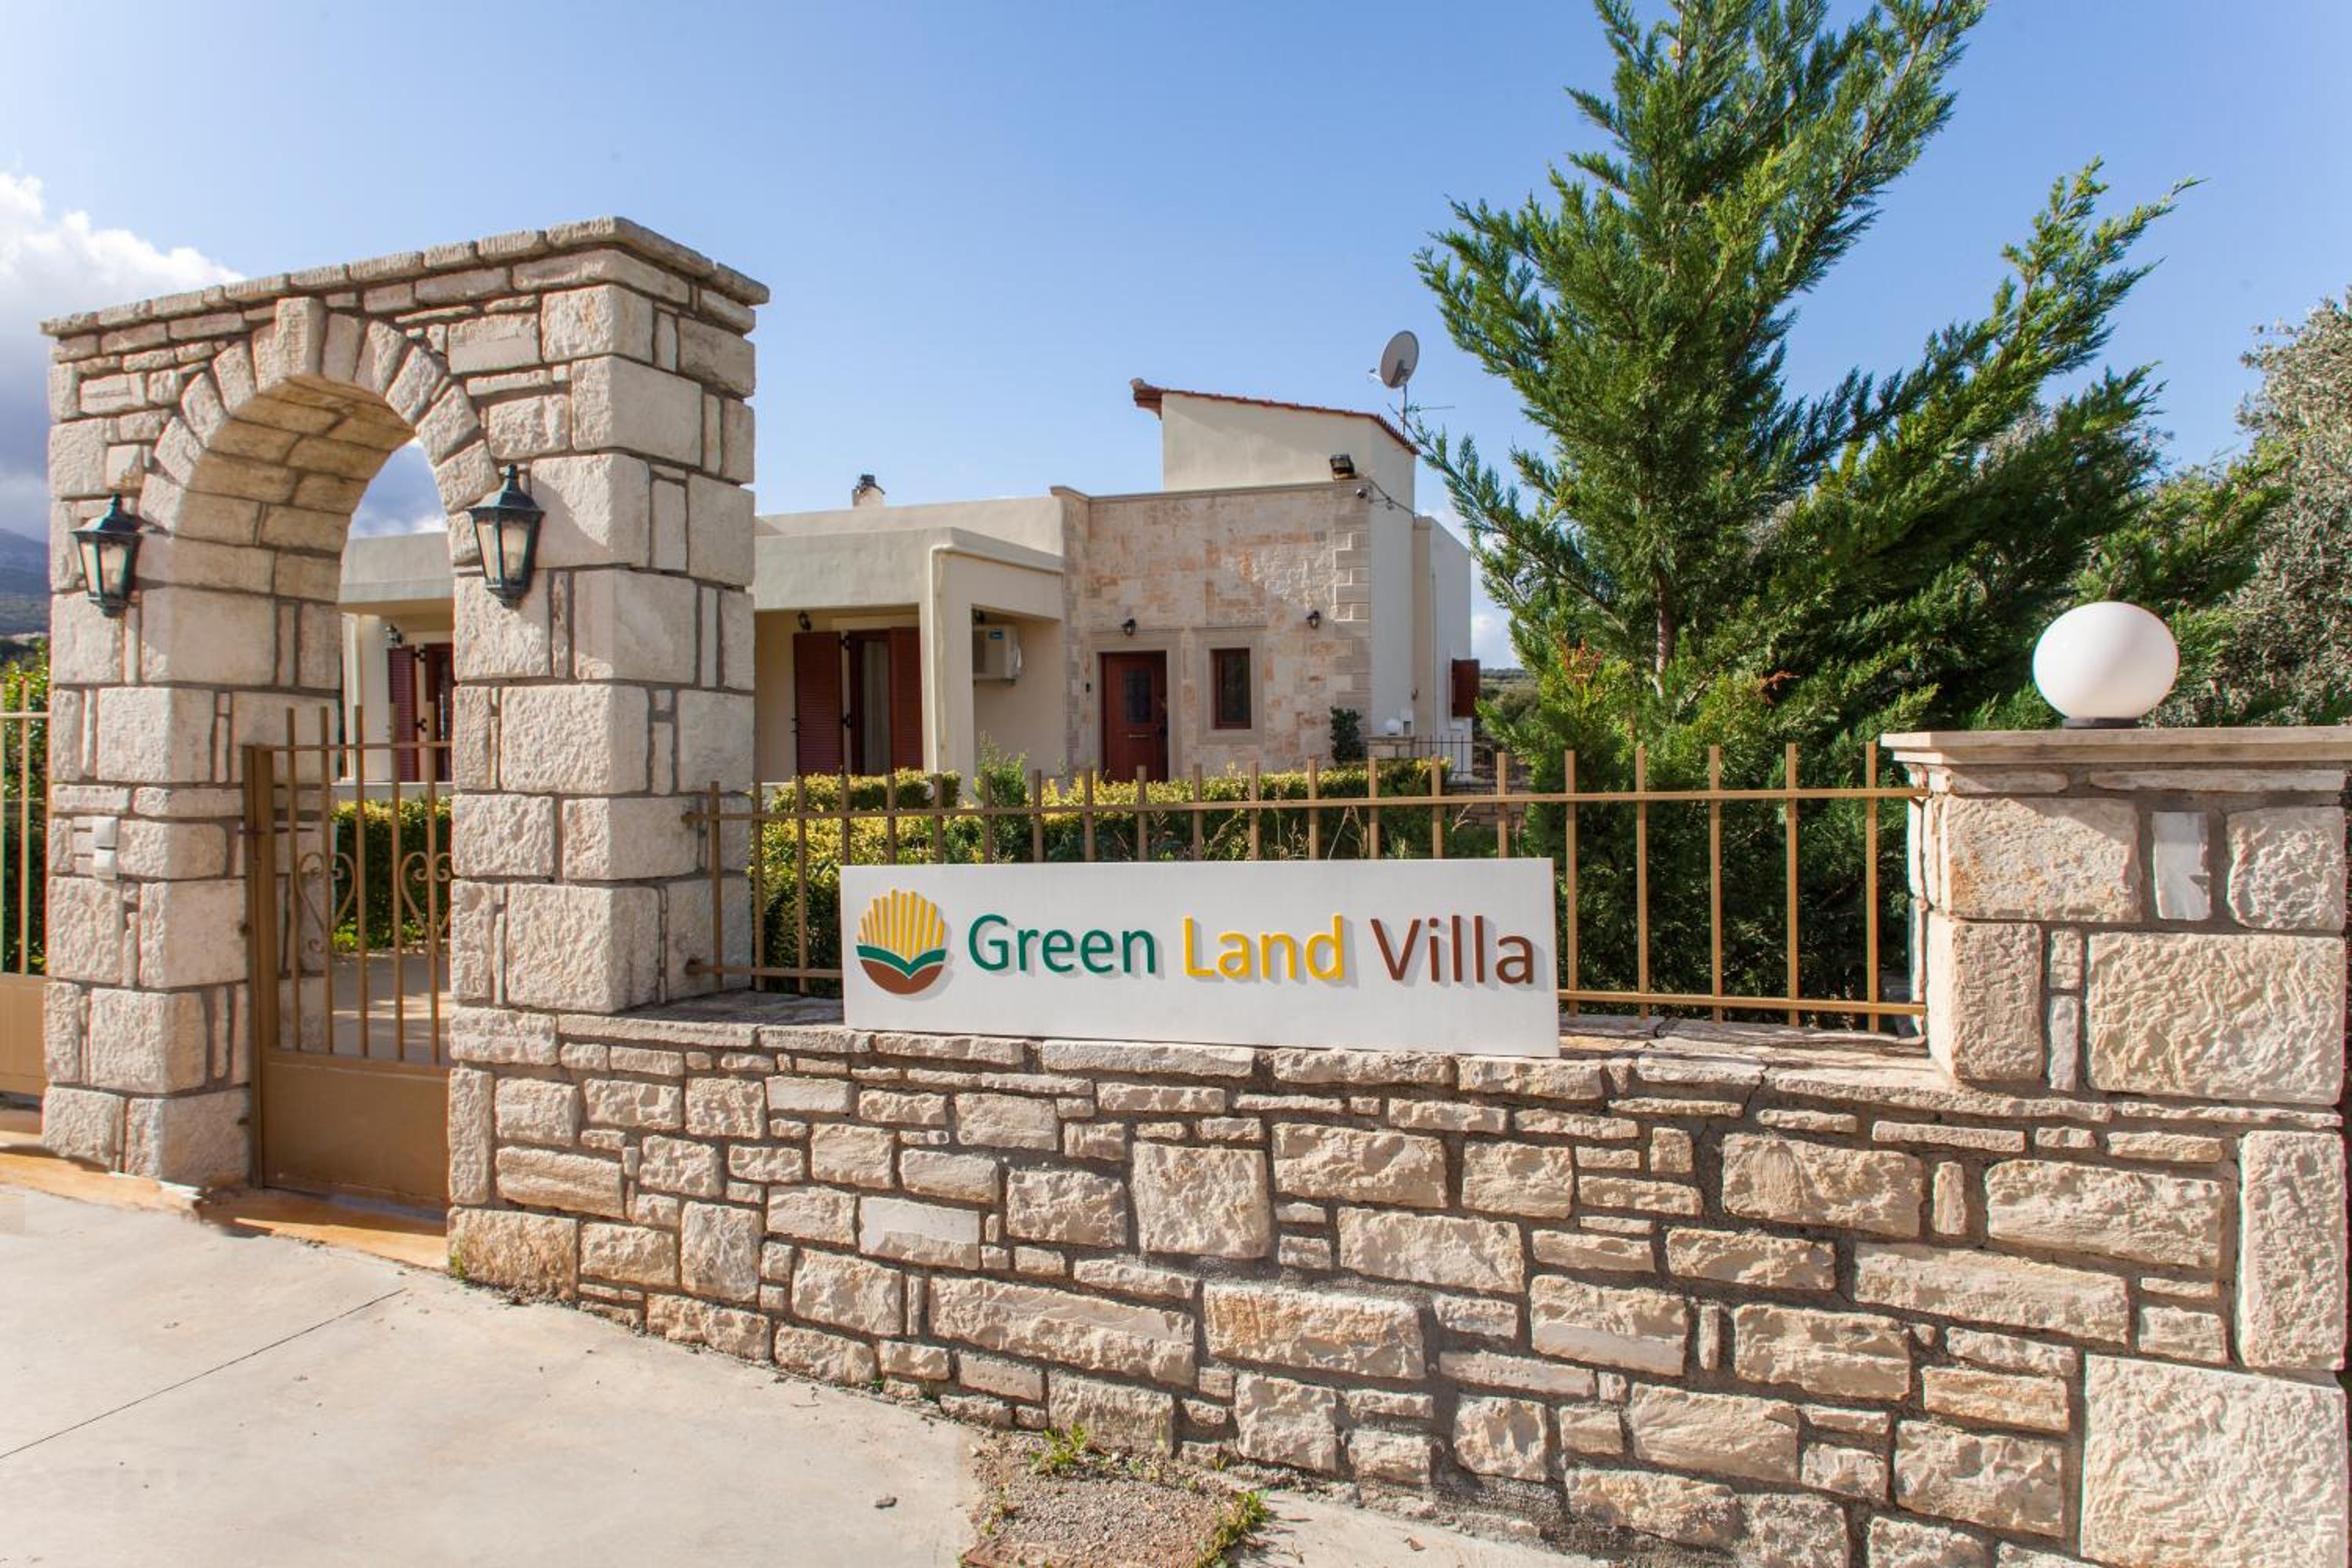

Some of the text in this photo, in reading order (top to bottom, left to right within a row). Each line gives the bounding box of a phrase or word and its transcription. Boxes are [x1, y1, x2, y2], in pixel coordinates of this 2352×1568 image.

[968, 914, 1534, 984] Green Land Villa
